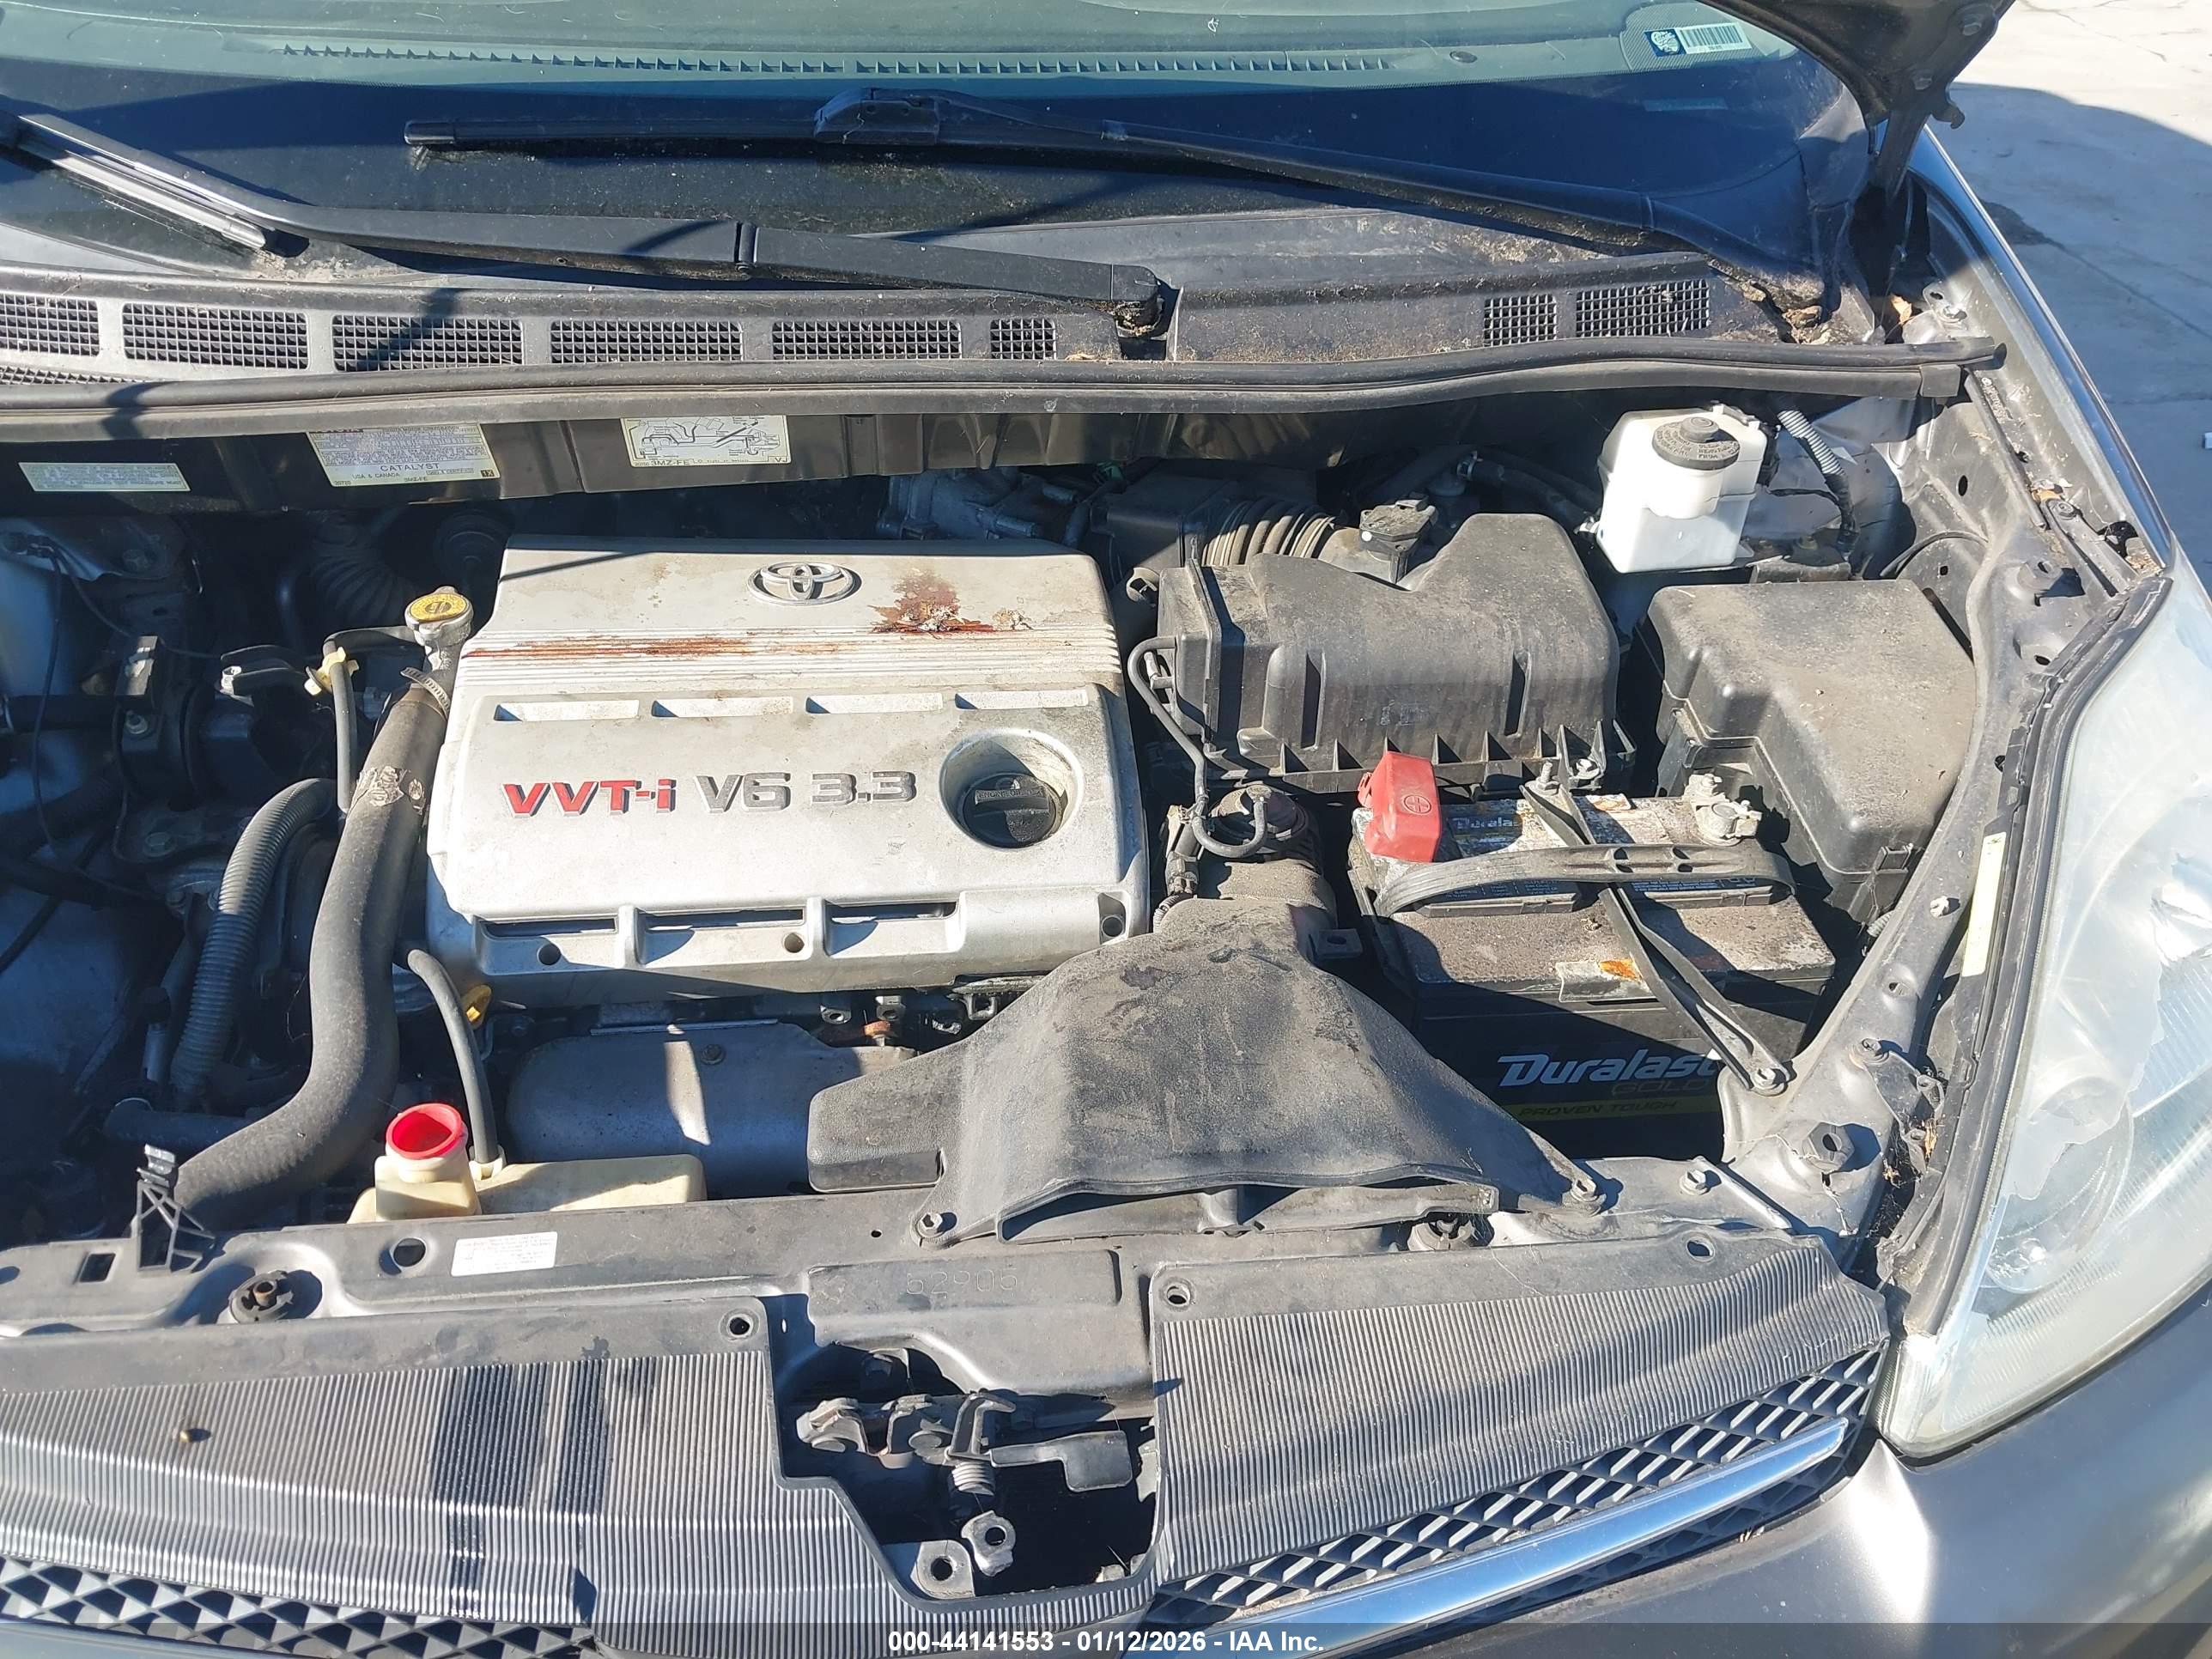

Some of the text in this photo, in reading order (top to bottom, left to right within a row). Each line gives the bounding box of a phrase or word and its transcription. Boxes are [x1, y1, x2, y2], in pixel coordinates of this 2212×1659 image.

[380, 462, 440, 471] CATALYST
[502, 770, 917, 817] VVT-i V6 3.3
[1611, 1079, 1709, 1096] GOLD
[1519, 1100, 1678, 1116] PROVEN TOUGH
